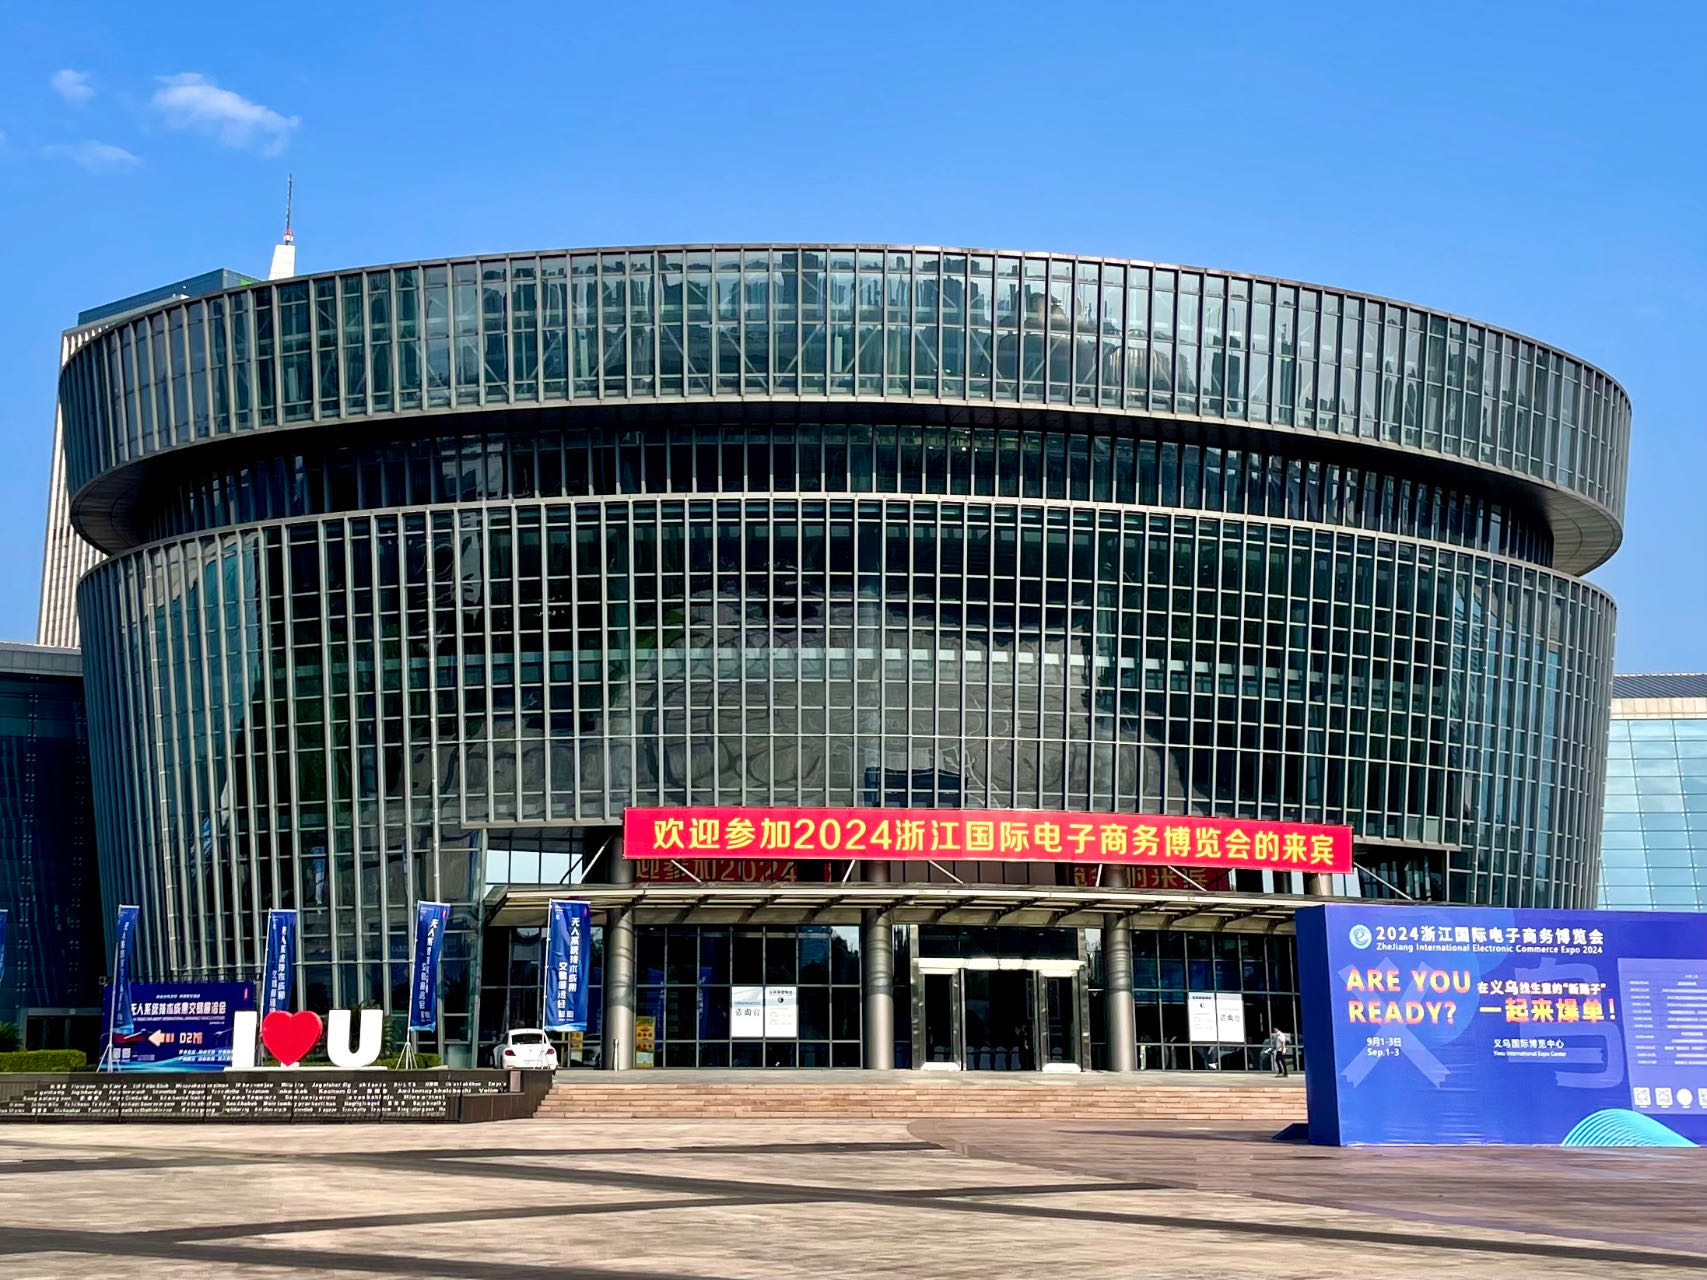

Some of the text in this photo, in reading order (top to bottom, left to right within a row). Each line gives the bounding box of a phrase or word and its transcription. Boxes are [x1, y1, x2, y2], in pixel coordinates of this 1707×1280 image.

[653, 817, 1334, 865] 欢迎参加2024浙江国际电子商务博览会的来宾
[1376, 925, 1604, 945] 2024浙江国际电子商务博览会
[1416, 943, 1470, 952] International
[1472, 944, 1513, 953] Electronic
[1516, 945, 1558, 954] Commerce
[1561, 945, 1580, 956] Expo
[1583, 946, 1603, 954] 2024
[1346, 968, 1471, 994] ARE YOU
[1348, 999, 1457, 1025] READY?
[232, 1009, 384, 1068] I U
[1366, 1036, 1402, 1047] 9月1-3日
